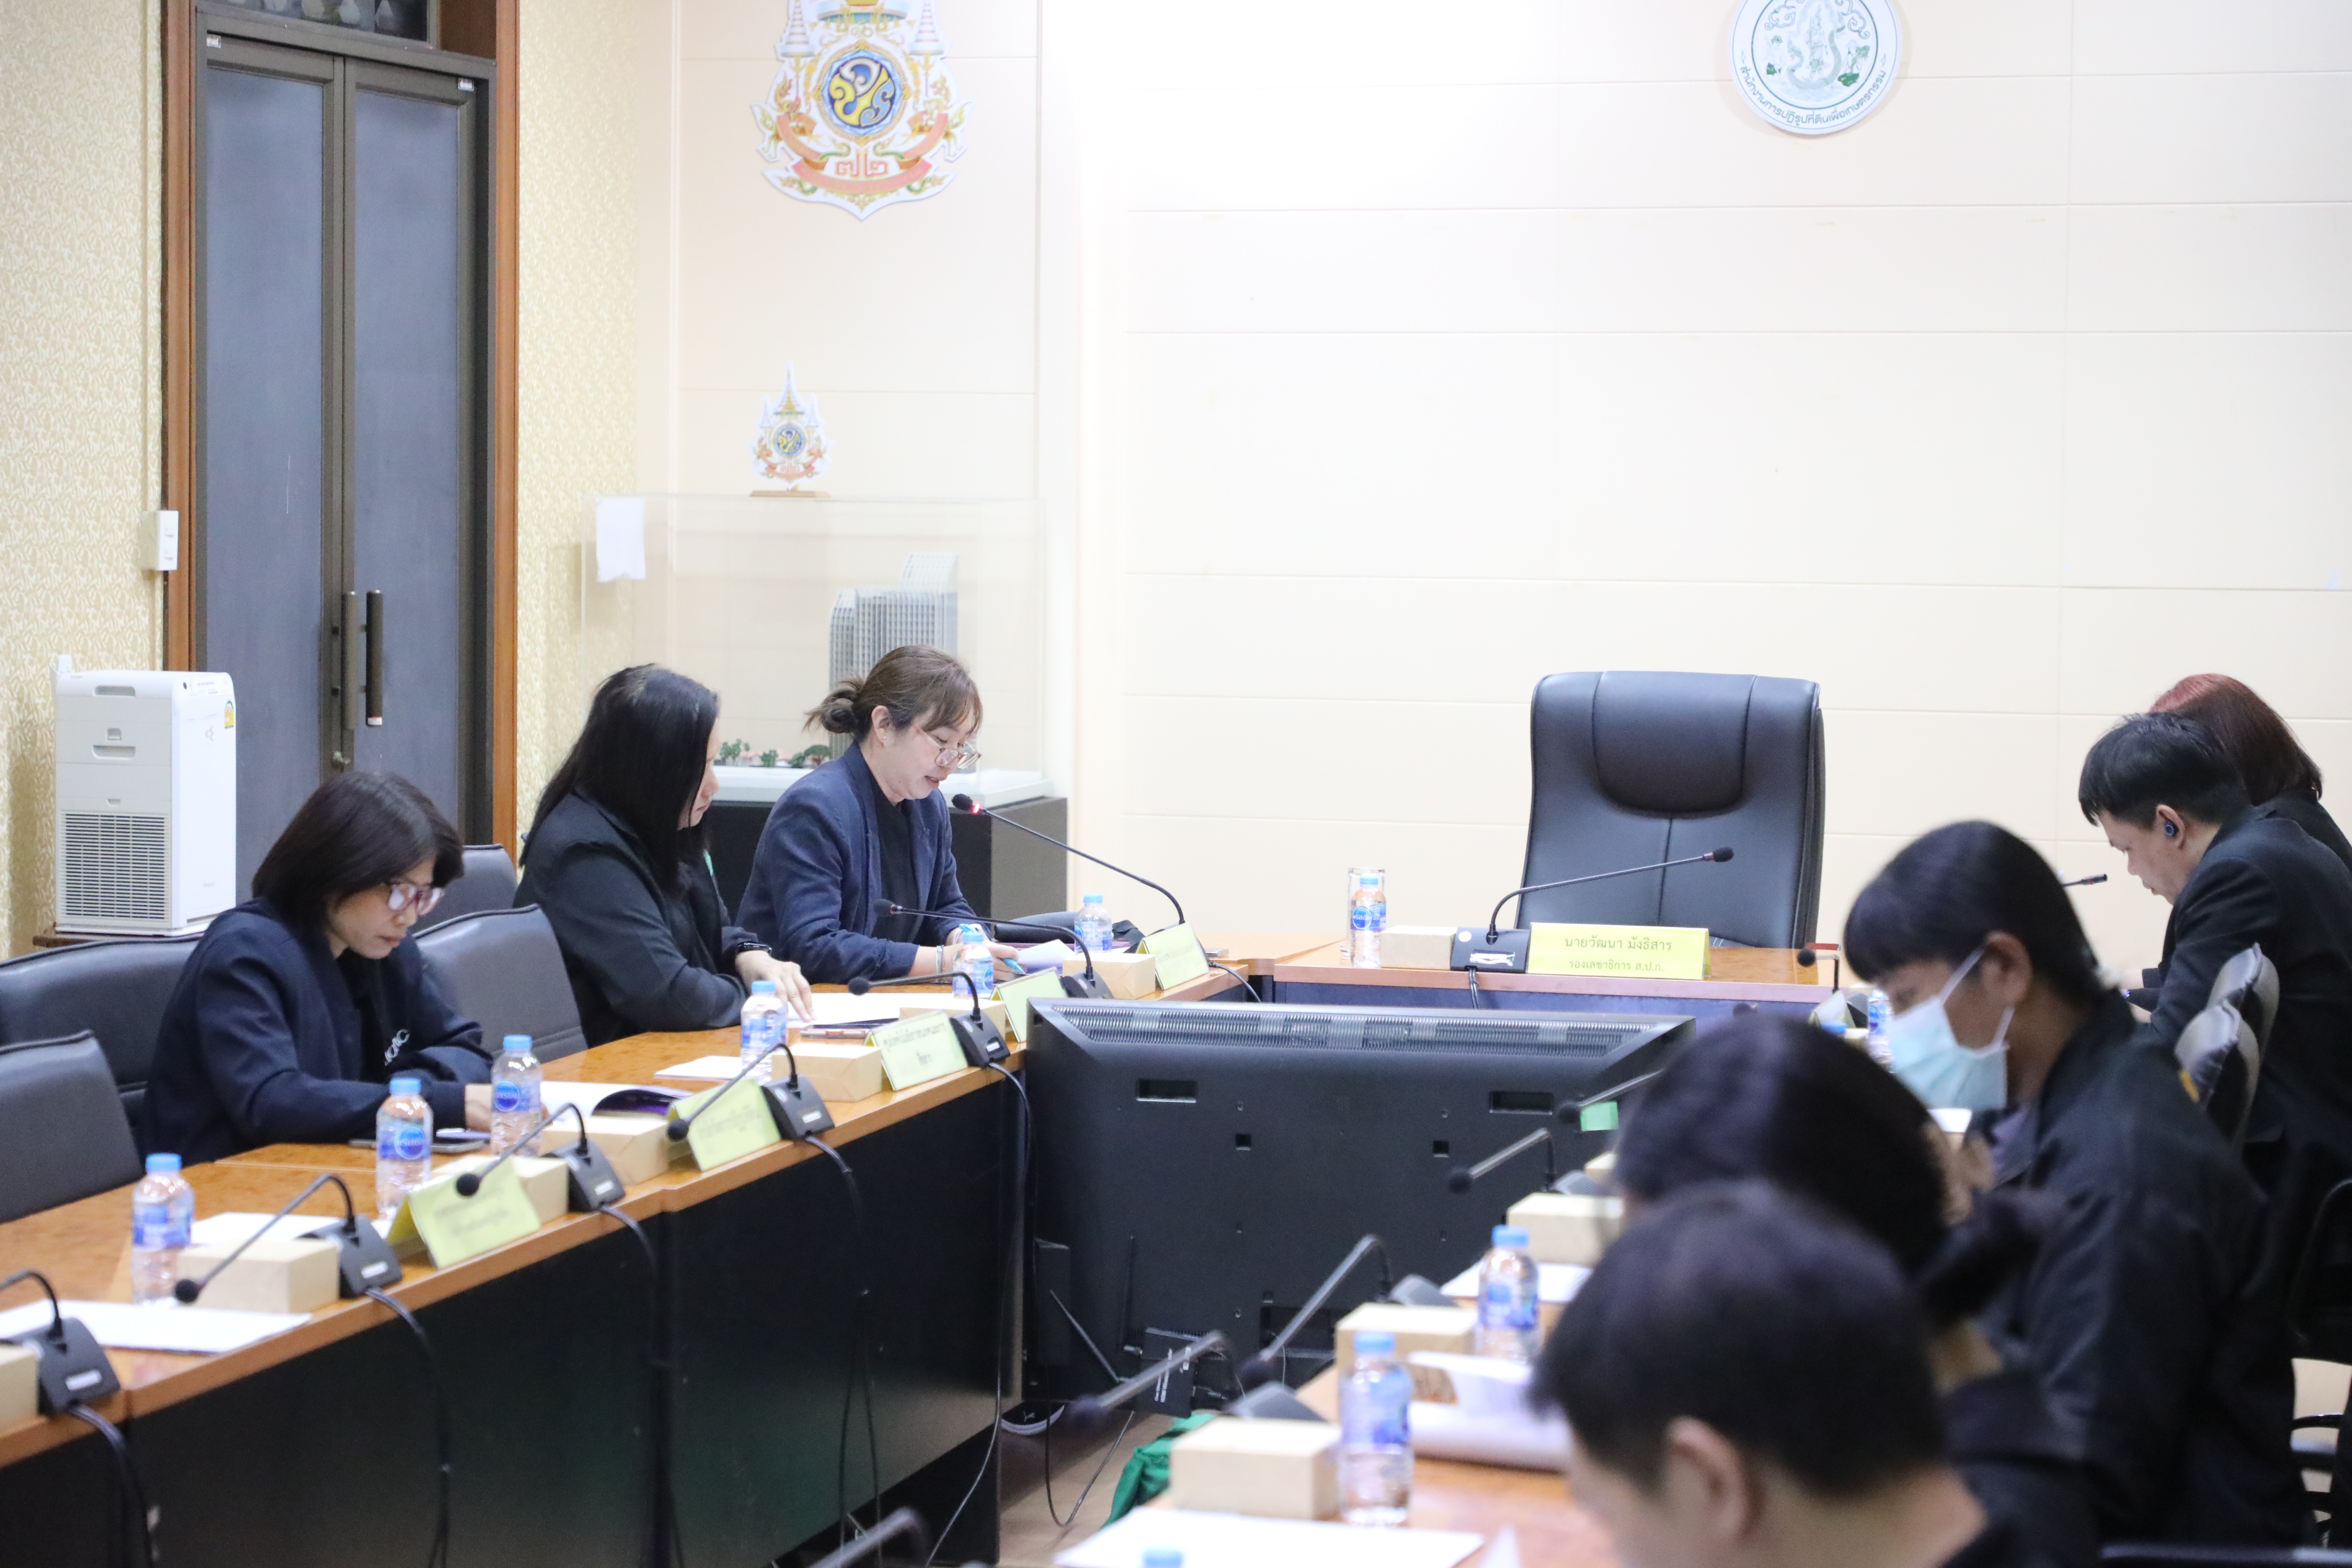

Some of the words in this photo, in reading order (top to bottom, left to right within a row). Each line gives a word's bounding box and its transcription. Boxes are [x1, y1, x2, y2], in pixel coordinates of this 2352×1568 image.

[1740, 66, 1886, 126] สำนักงานการปฏิรูปที่ดินเพื่อเกษตรกรรม
[1565, 935, 1622, 948] นายวัฒนา
[1628, 936, 1672, 950] มังธิสาร
[1569, 958, 1631, 970] รองเลขาธิการ
[1635, 962, 1663, 971] ส.ป.ก.
